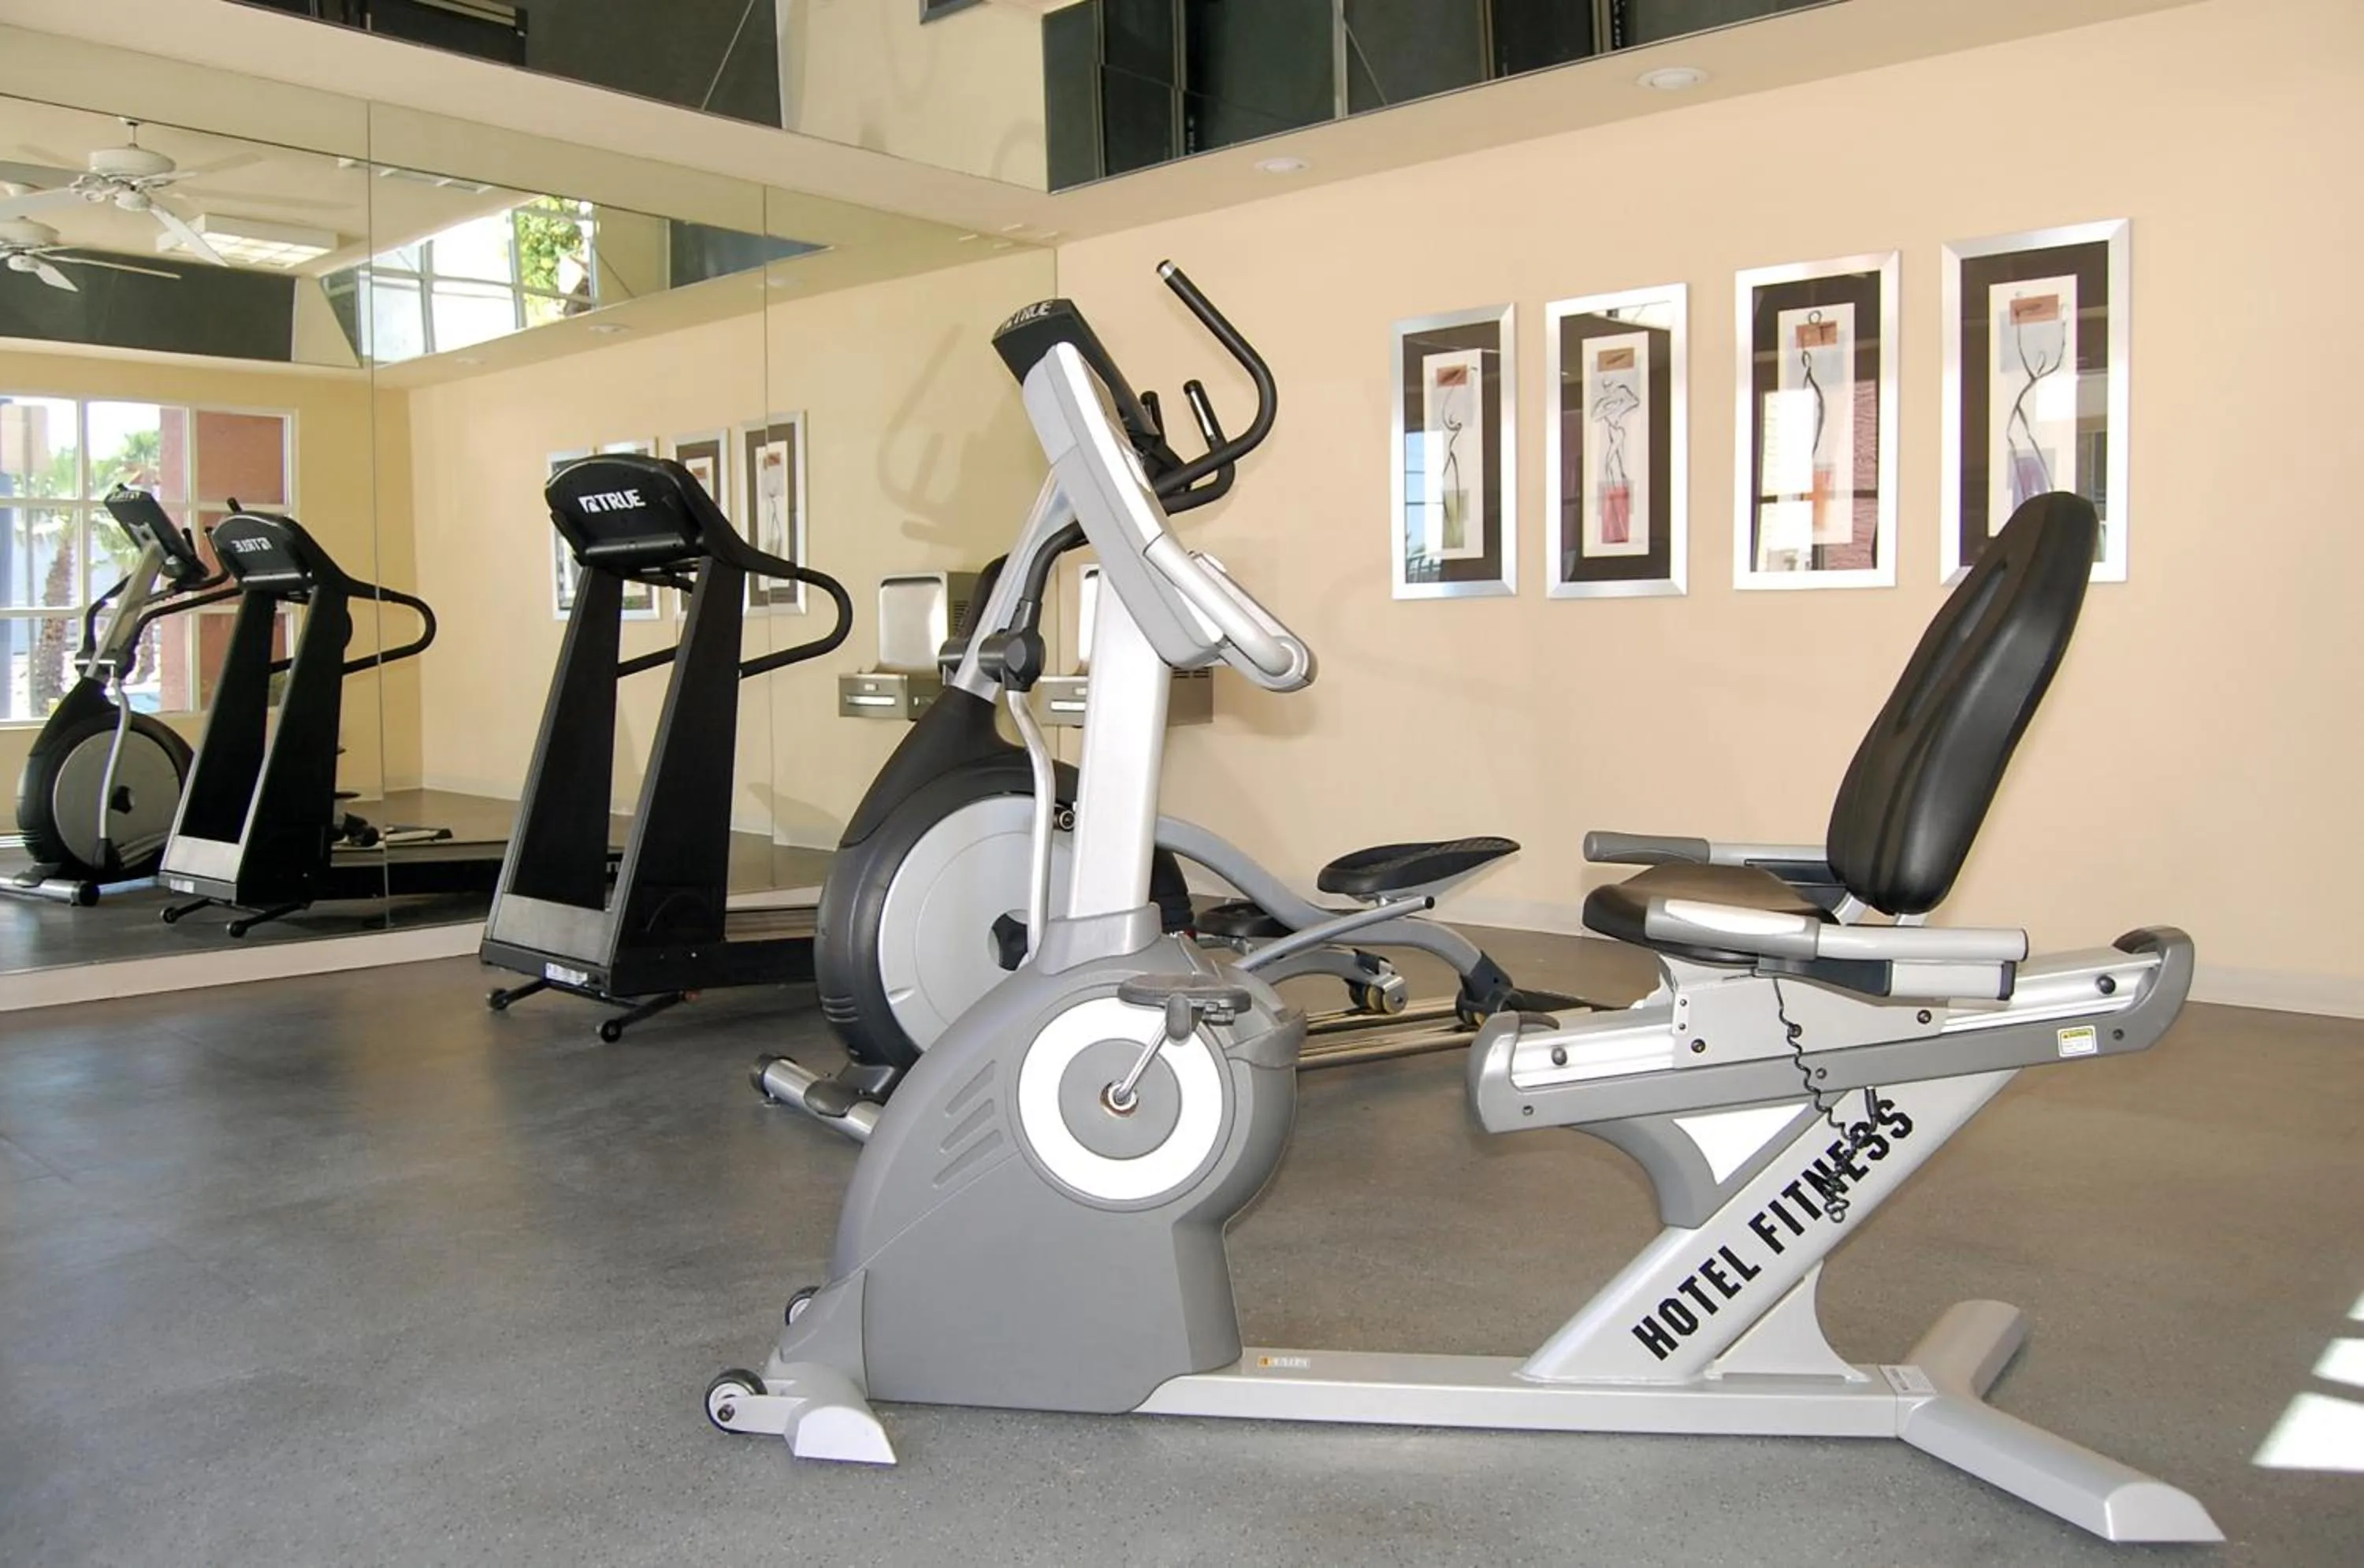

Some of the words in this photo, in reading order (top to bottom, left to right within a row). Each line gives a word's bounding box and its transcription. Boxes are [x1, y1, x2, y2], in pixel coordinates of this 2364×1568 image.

[595, 489, 646, 511] TRUE
[1632, 1246, 1762, 1362] HOTEL
[1748, 1099, 1913, 1255] FITNESS
